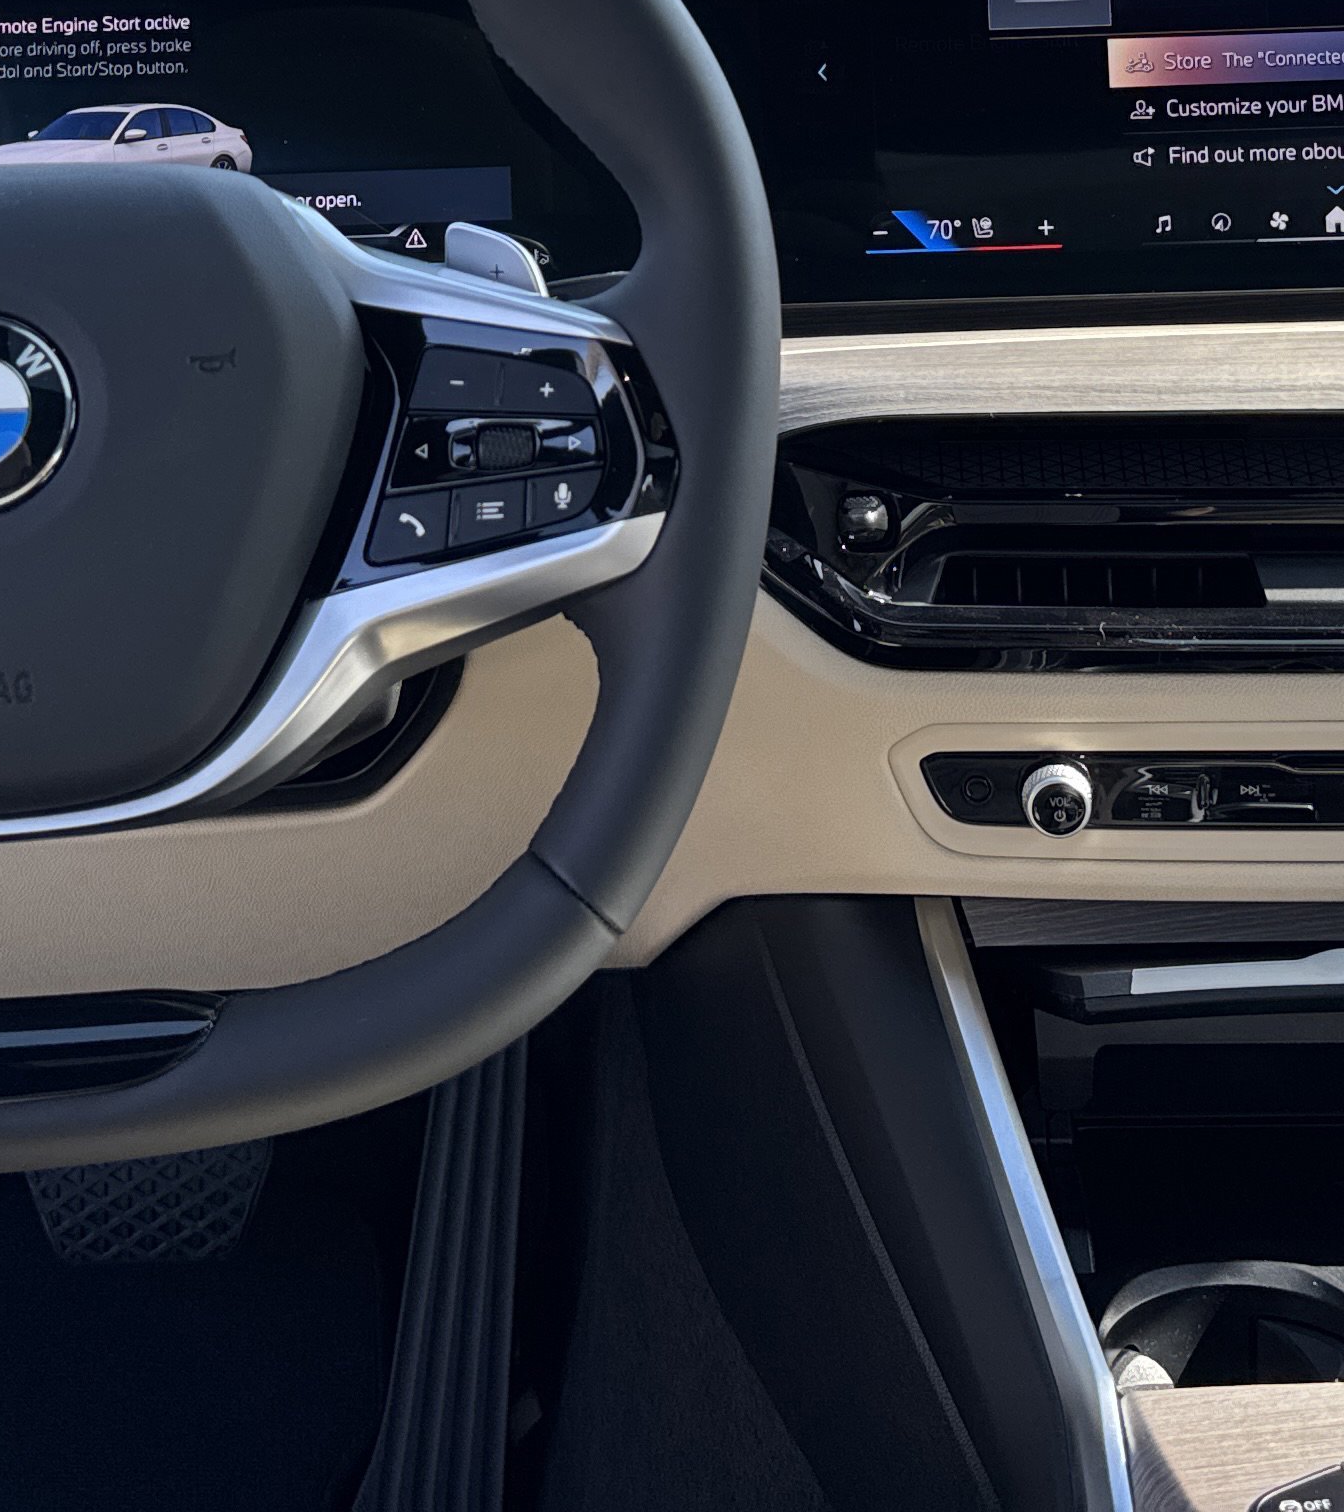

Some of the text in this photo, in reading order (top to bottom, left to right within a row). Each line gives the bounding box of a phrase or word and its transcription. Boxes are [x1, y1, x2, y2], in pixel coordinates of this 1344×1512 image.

[42, 16, 98, 36] Engine
[102, 16, 141, 32] Start
[144, 14, 191, 31] active
[27, 41, 77, 59] driving
[80, 40, 103, 57] off,
[106, 42, 147, 57] press
[151, 38, 192, 54] brake
[23, 63, 52, 79] and
[56, 60, 134, 79] Start/Stop
[137, 60, 189, 76] button.
[1164, 52, 1212, 71] Store
[1222, 51, 1254, 69] The
[1166, 97, 1262, 117] Customize
[1266, 98, 1308, 118] your
[1169, 146, 1209, 165] Find
[1214, 146, 1244, 163] out
[1249, 146, 1296, 162] more
[315, 194, 362, 211] open.
[1049, 796, 1071, 809] VOL
[1303, 1498, 1333, 1512] OFF
